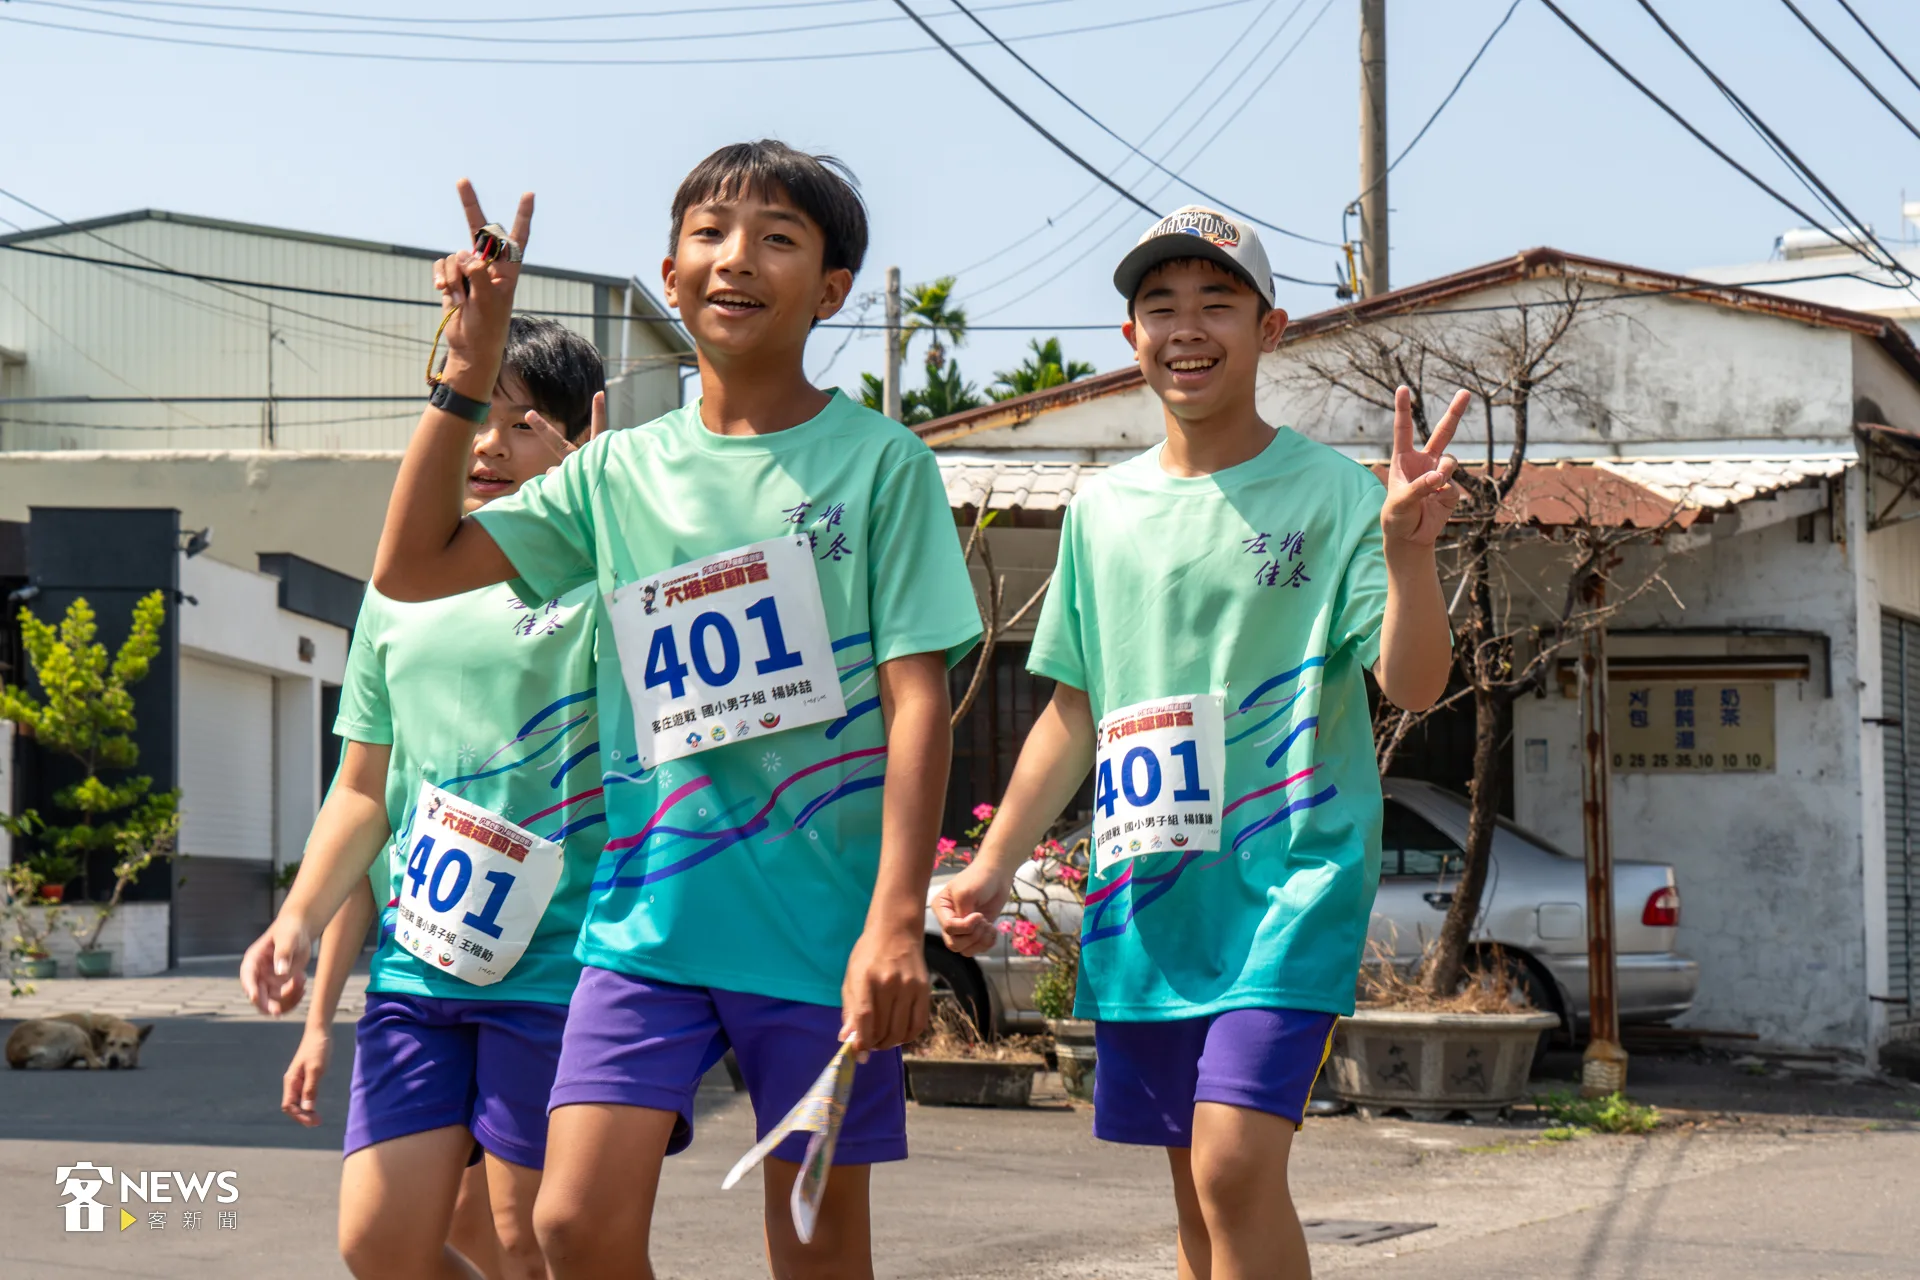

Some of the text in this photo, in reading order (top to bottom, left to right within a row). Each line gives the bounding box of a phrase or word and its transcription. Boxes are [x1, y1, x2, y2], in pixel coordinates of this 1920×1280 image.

[1242, 531, 1304, 562] 左堆
[664, 562, 770, 608] 六堆運動會
[1254, 559, 1311, 588] 佳冬
[644, 596, 803, 699] 401
[652, 709, 697, 734] 客庄遊戰
[702, 690, 767, 718] 國小男子組
[1108, 711, 1194, 743] 六堆運動會
[1720, 689, 1740, 727] 奶茶
[1097, 740, 1210, 818] 401
[1629, 754, 1645, 767] 25
[1652, 754, 1668, 767] 25
[1675, 754, 1692, 767] 35
[1699, 754, 1713, 767] 10
[1722, 754, 1737, 767] 10
[1746, 754, 1761, 767] 10
[441, 811, 530, 864] 六堆運動會
[1124, 815, 1179, 833] 國小男子組
[407, 834, 516, 940] 401
[415, 916, 457, 945] 國小男子組
